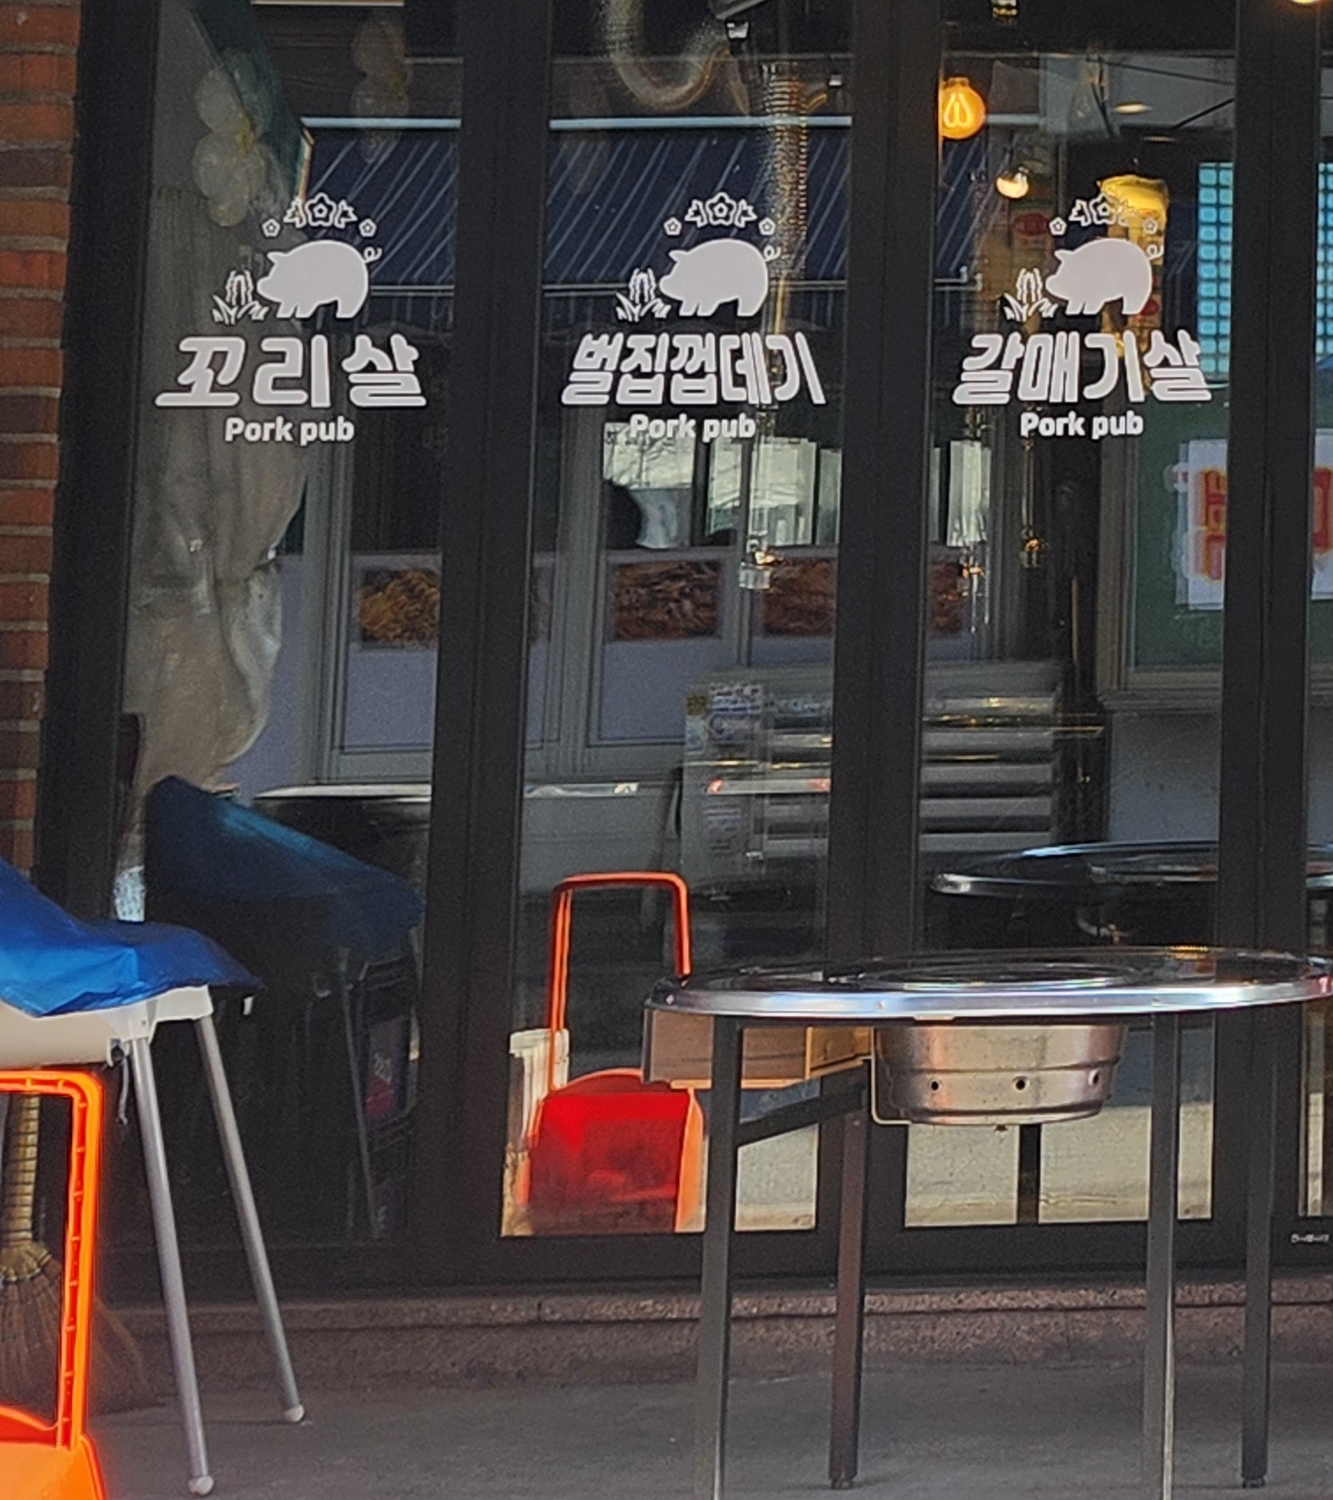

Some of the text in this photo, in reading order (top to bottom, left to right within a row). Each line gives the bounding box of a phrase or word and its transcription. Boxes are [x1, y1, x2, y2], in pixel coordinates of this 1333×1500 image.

[155, 333, 427, 408] 꼬리살
[561, 332, 827, 405] 벌집껍데기
[952, 330, 1213, 405] 갈매기살
[225, 415, 355, 447] Pork pub
[630, 412, 756, 443] Pork pub
[1020, 410, 1144, 440] Pork pub
